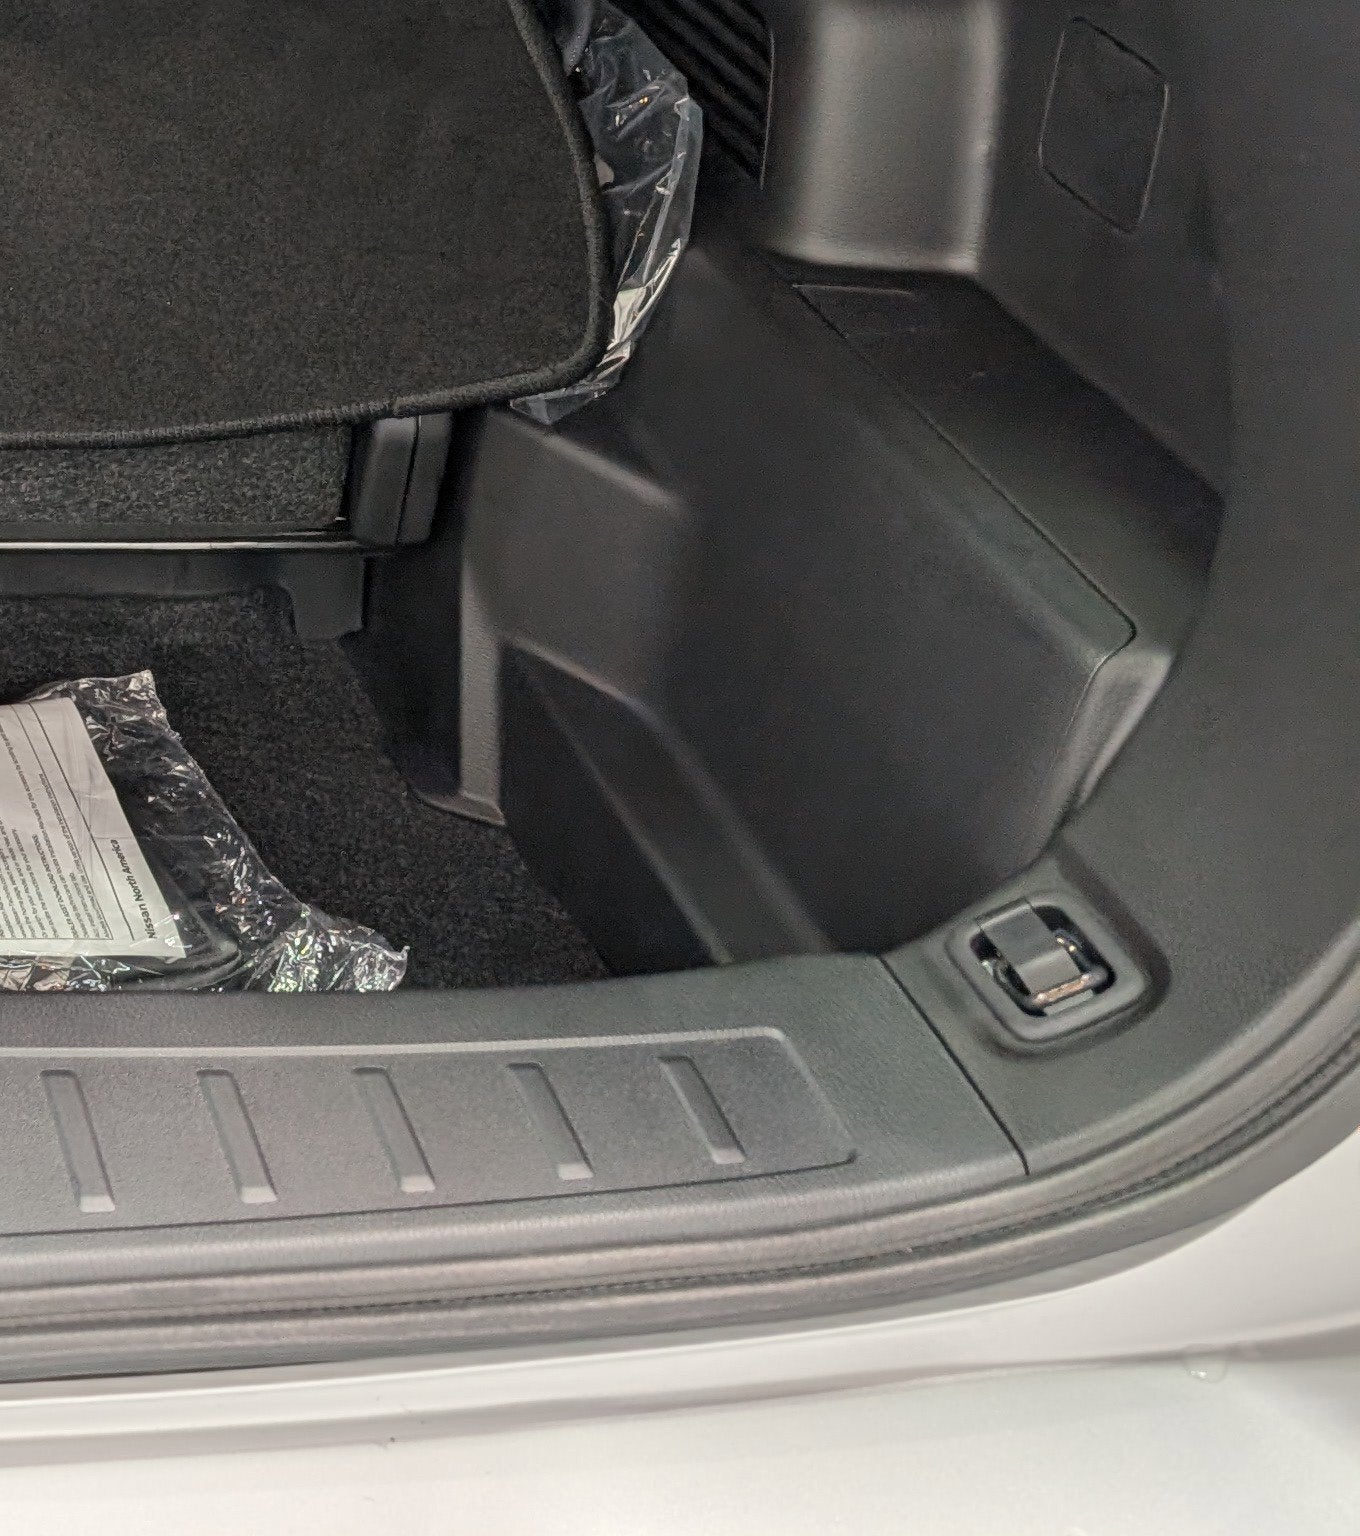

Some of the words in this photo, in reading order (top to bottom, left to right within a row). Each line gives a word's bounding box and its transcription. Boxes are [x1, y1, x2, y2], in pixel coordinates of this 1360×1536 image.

[110, 839, 131, 873] America
[126, 875, 143, 901] North
[139, 903, 156, 938] Nissan
